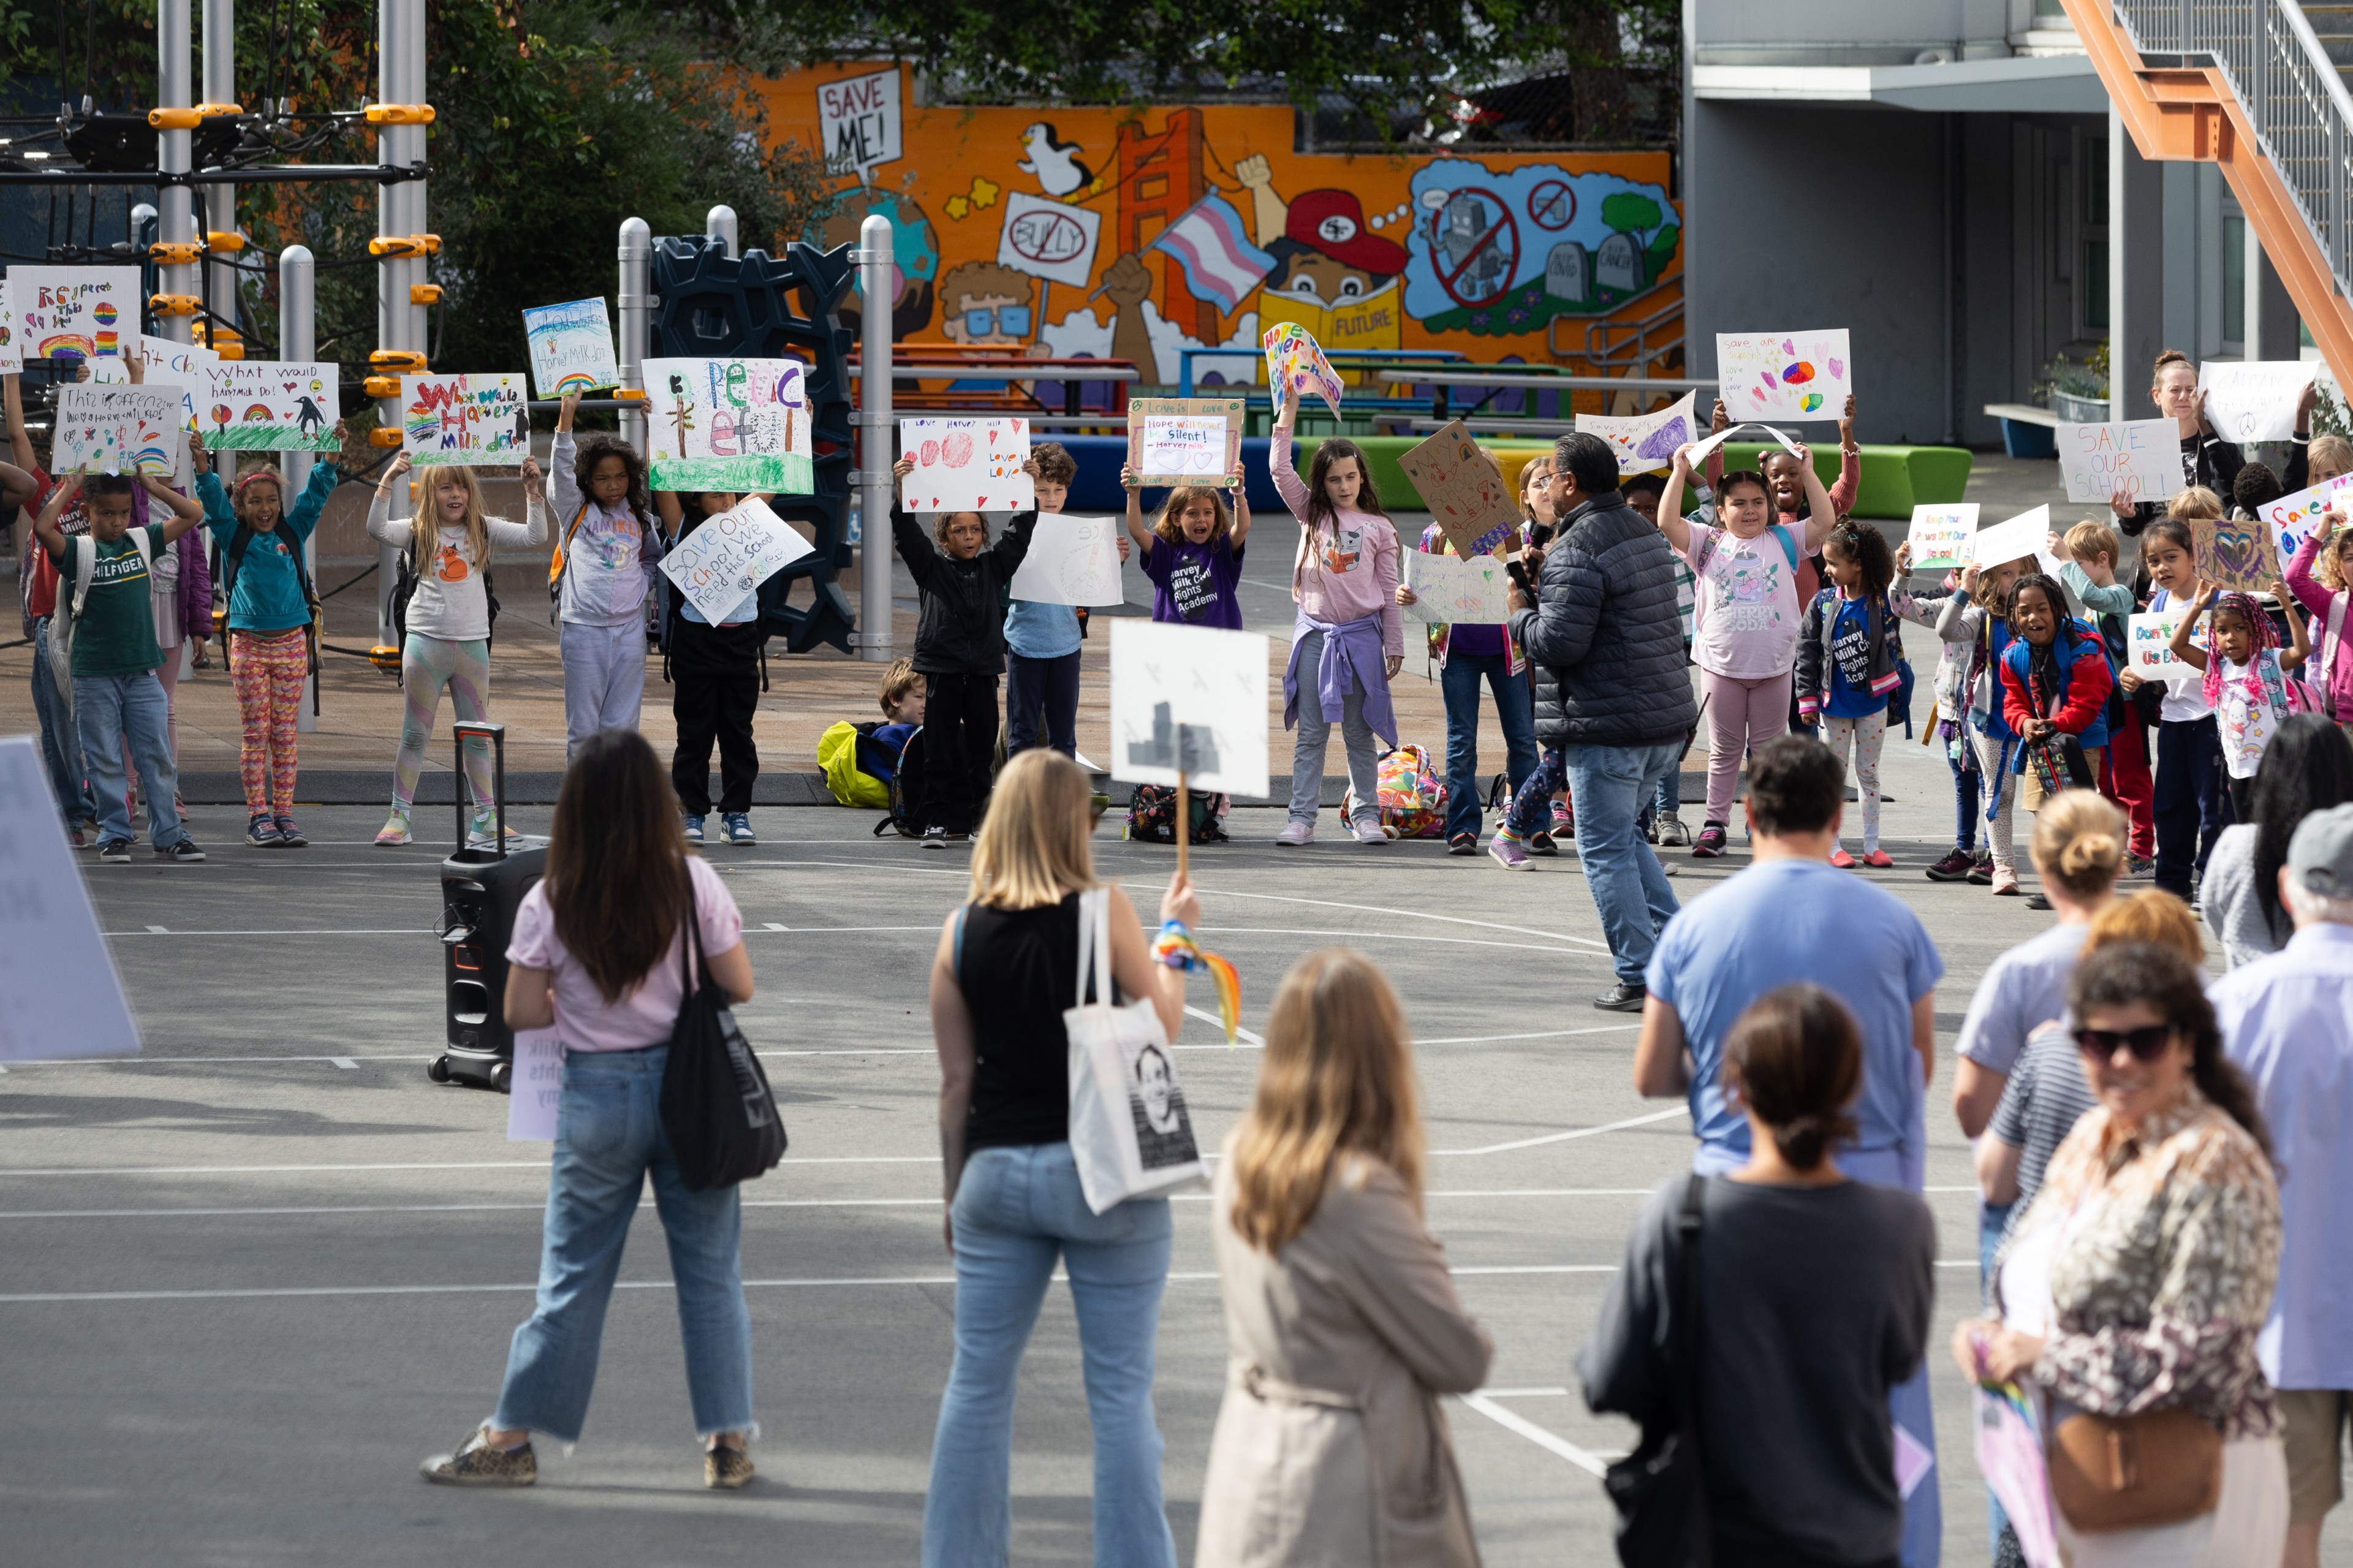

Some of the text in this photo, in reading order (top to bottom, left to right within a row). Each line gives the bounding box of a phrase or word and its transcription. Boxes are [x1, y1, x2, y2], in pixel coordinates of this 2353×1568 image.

[825, 76, 885, 119] SAVE
[839, 112, 884, 164] ME!
[1015, 219, 1082, 255] BULLY
[1336, 308, 1392, 336] FUTURE
[1265, 324, 1303, 351] Hope
[1724, 337, 1776, 350] Save are
[1148, 402, 1175, 414] Love
[1177, 403, 1186, 413] is
[1149, 430, 1161, 438] be
[1176, 420, 1195, 429] will
[1197, 422, 1222, 430] never
[2078, 425, 2146, 453] SAVE
[2091, 452, 2132, 473] OUR
[2075, 473, 2166, 498] SCHOOL!
[1925, 514, 1962, 526] Keep Your
[2272, 506, 2322, 529] Save
[61, 521, 84, 535] Milk
[1953, 530, 1968, 540] Our
[2281, 530, 2311, 555] Ou
[667, 528, 719, 583] Save
[1926, 547, 1952, 558] School
[1170, 565, 1200, 582] Harvey
[695, 572, 729, 608] need
[1172, 577, 1192, 591] Milk
[1174, 585, 1202, 603] Rights
[1178, 592, 1218, 613] Academy
[1832, 630, 1864, 651] Harvey
[2136, 623, 2172, 641] Don't
[1834, 645, 1859, 662] Milk
[2142, 650, 2161, 665] Us
[1840, 655, 1869, 673] Rights
